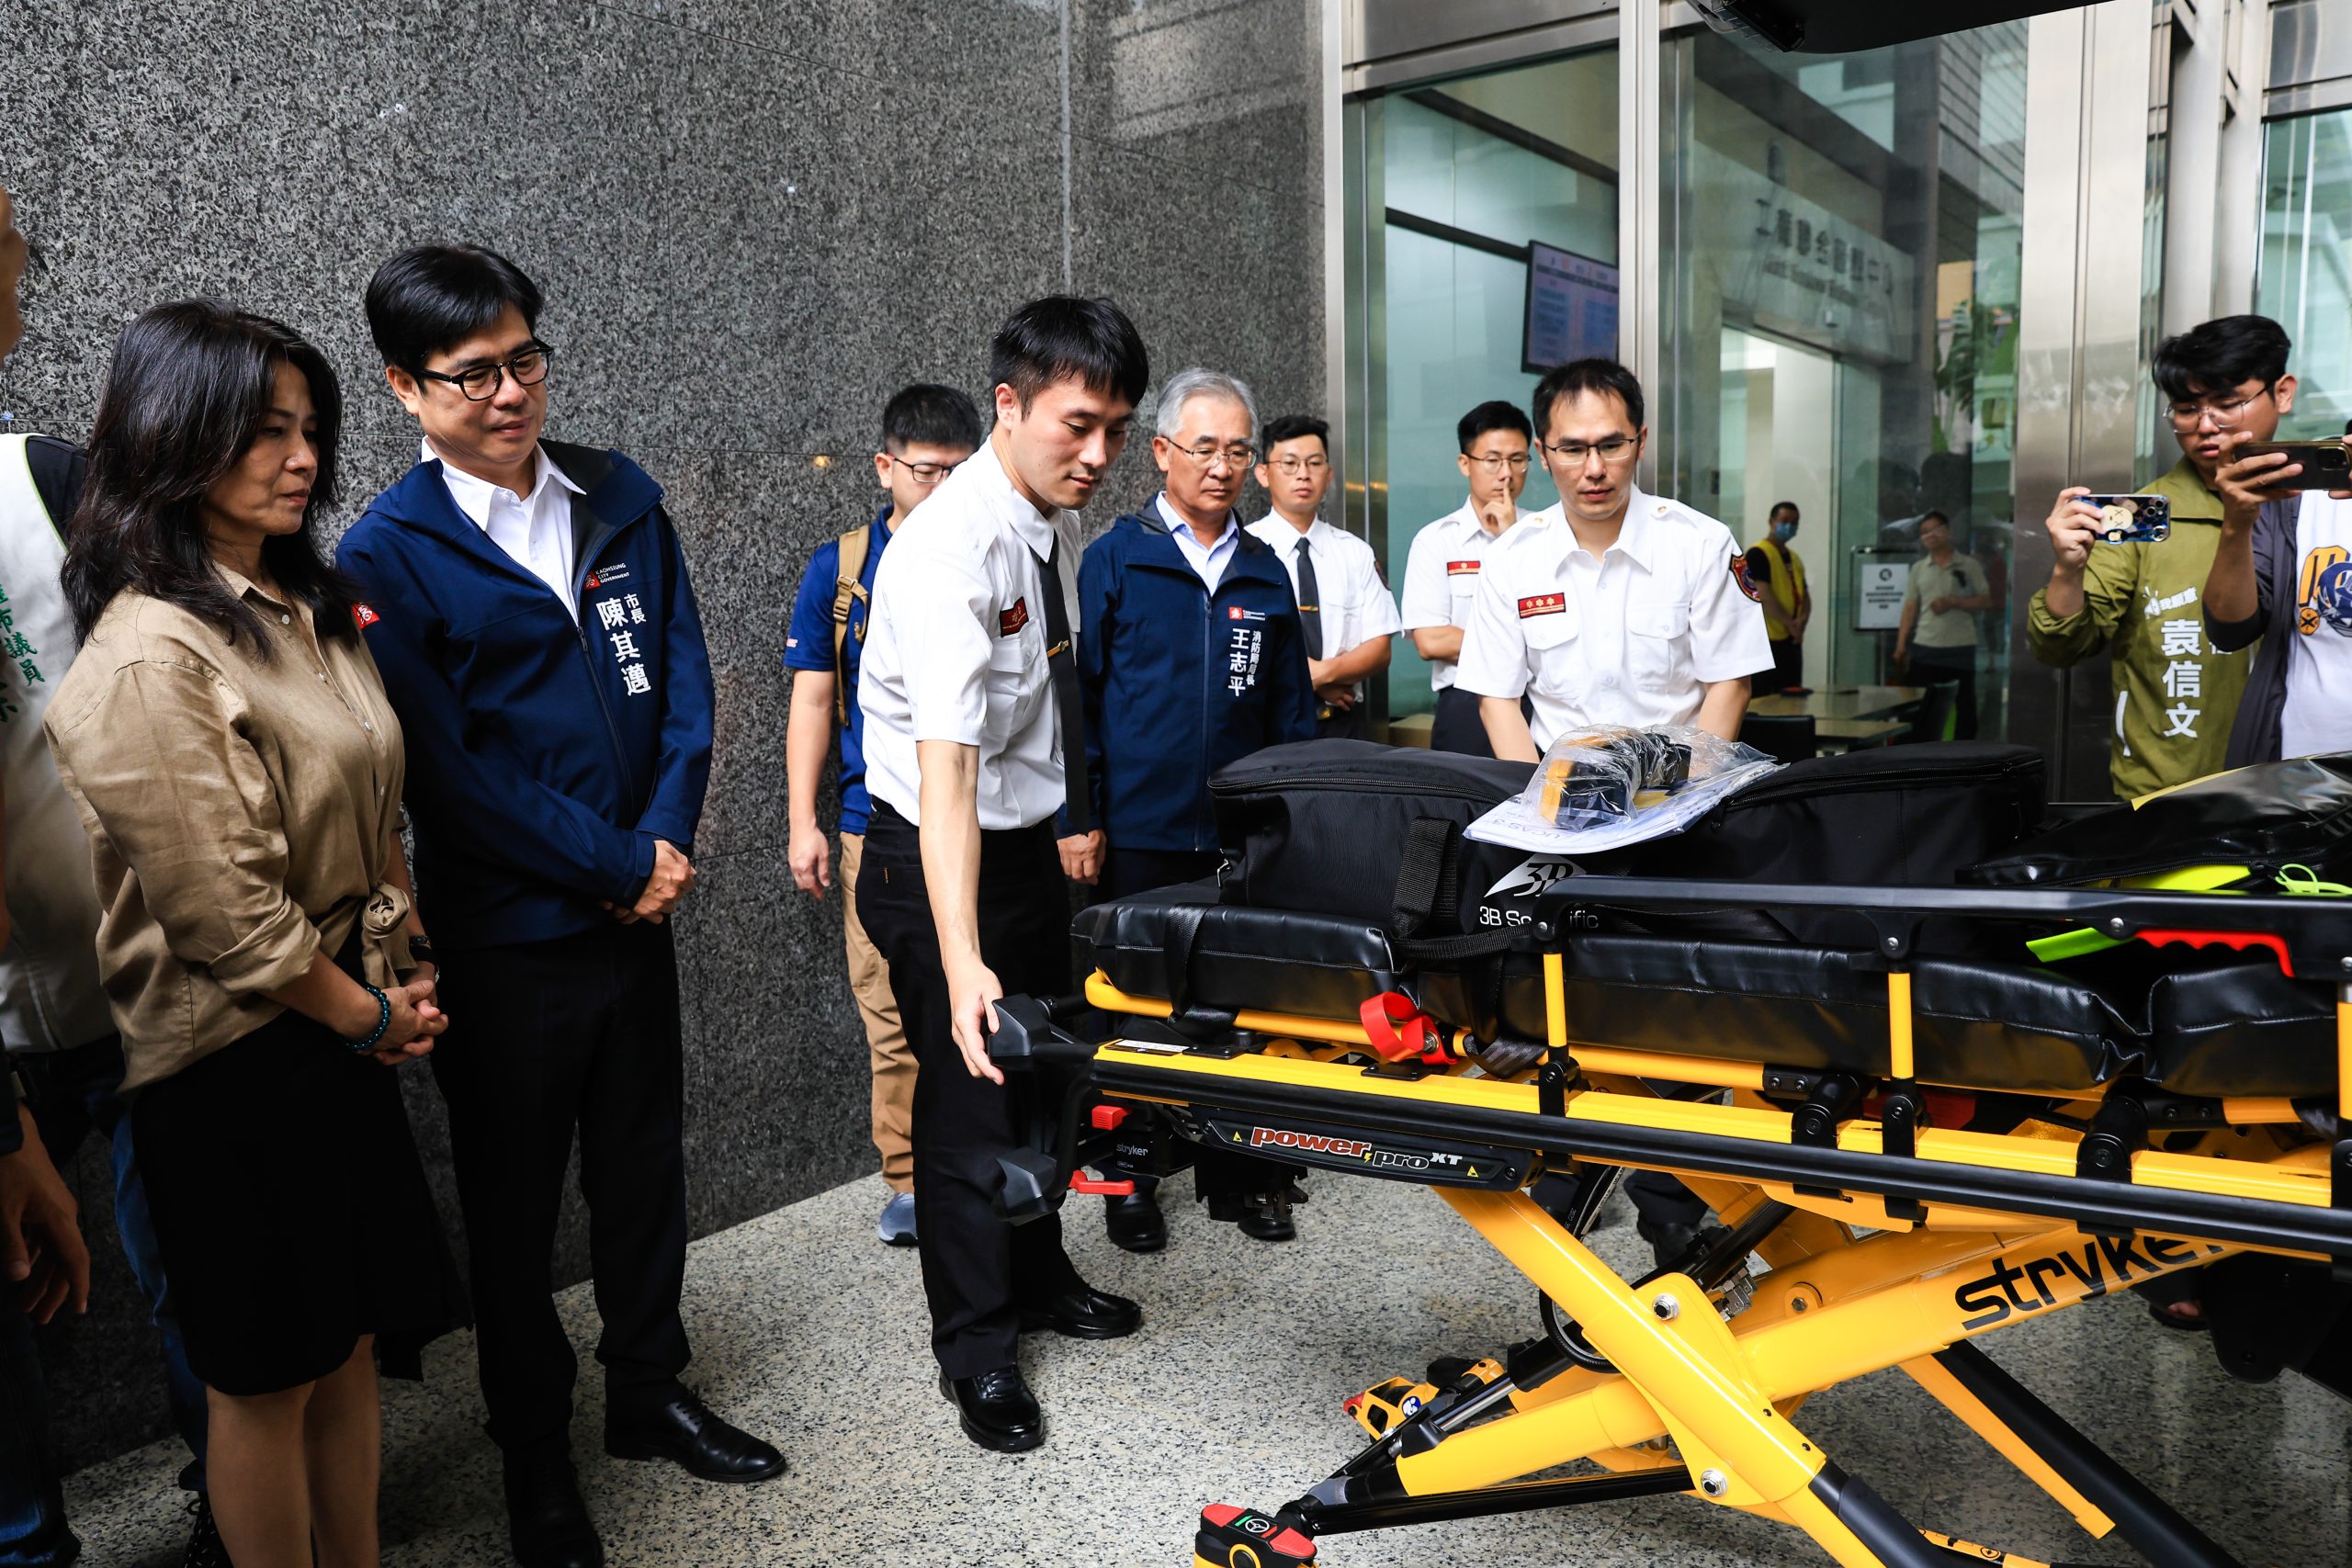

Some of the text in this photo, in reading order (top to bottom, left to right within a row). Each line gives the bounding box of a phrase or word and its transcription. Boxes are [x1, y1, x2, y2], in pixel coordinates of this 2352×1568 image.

[595, 563, 626, 575] KAOHSIUNG
[600, 572, 629, 583] GOVERNMENT
[624, 593, 647, 625] 市長
[596, 598, 651, 696] 陳其邁
[1228, 628, 1250, 696] 王志平
[2161, 619, 2202, 739] 袁信文
[1479, 906, 1501, 926] 3B
[1116, 1143, 1148, 1156] stryker
[1250, 1127, 1463, 1169] power pro XT
[1955, 1235, 2223, 1330] stryke
